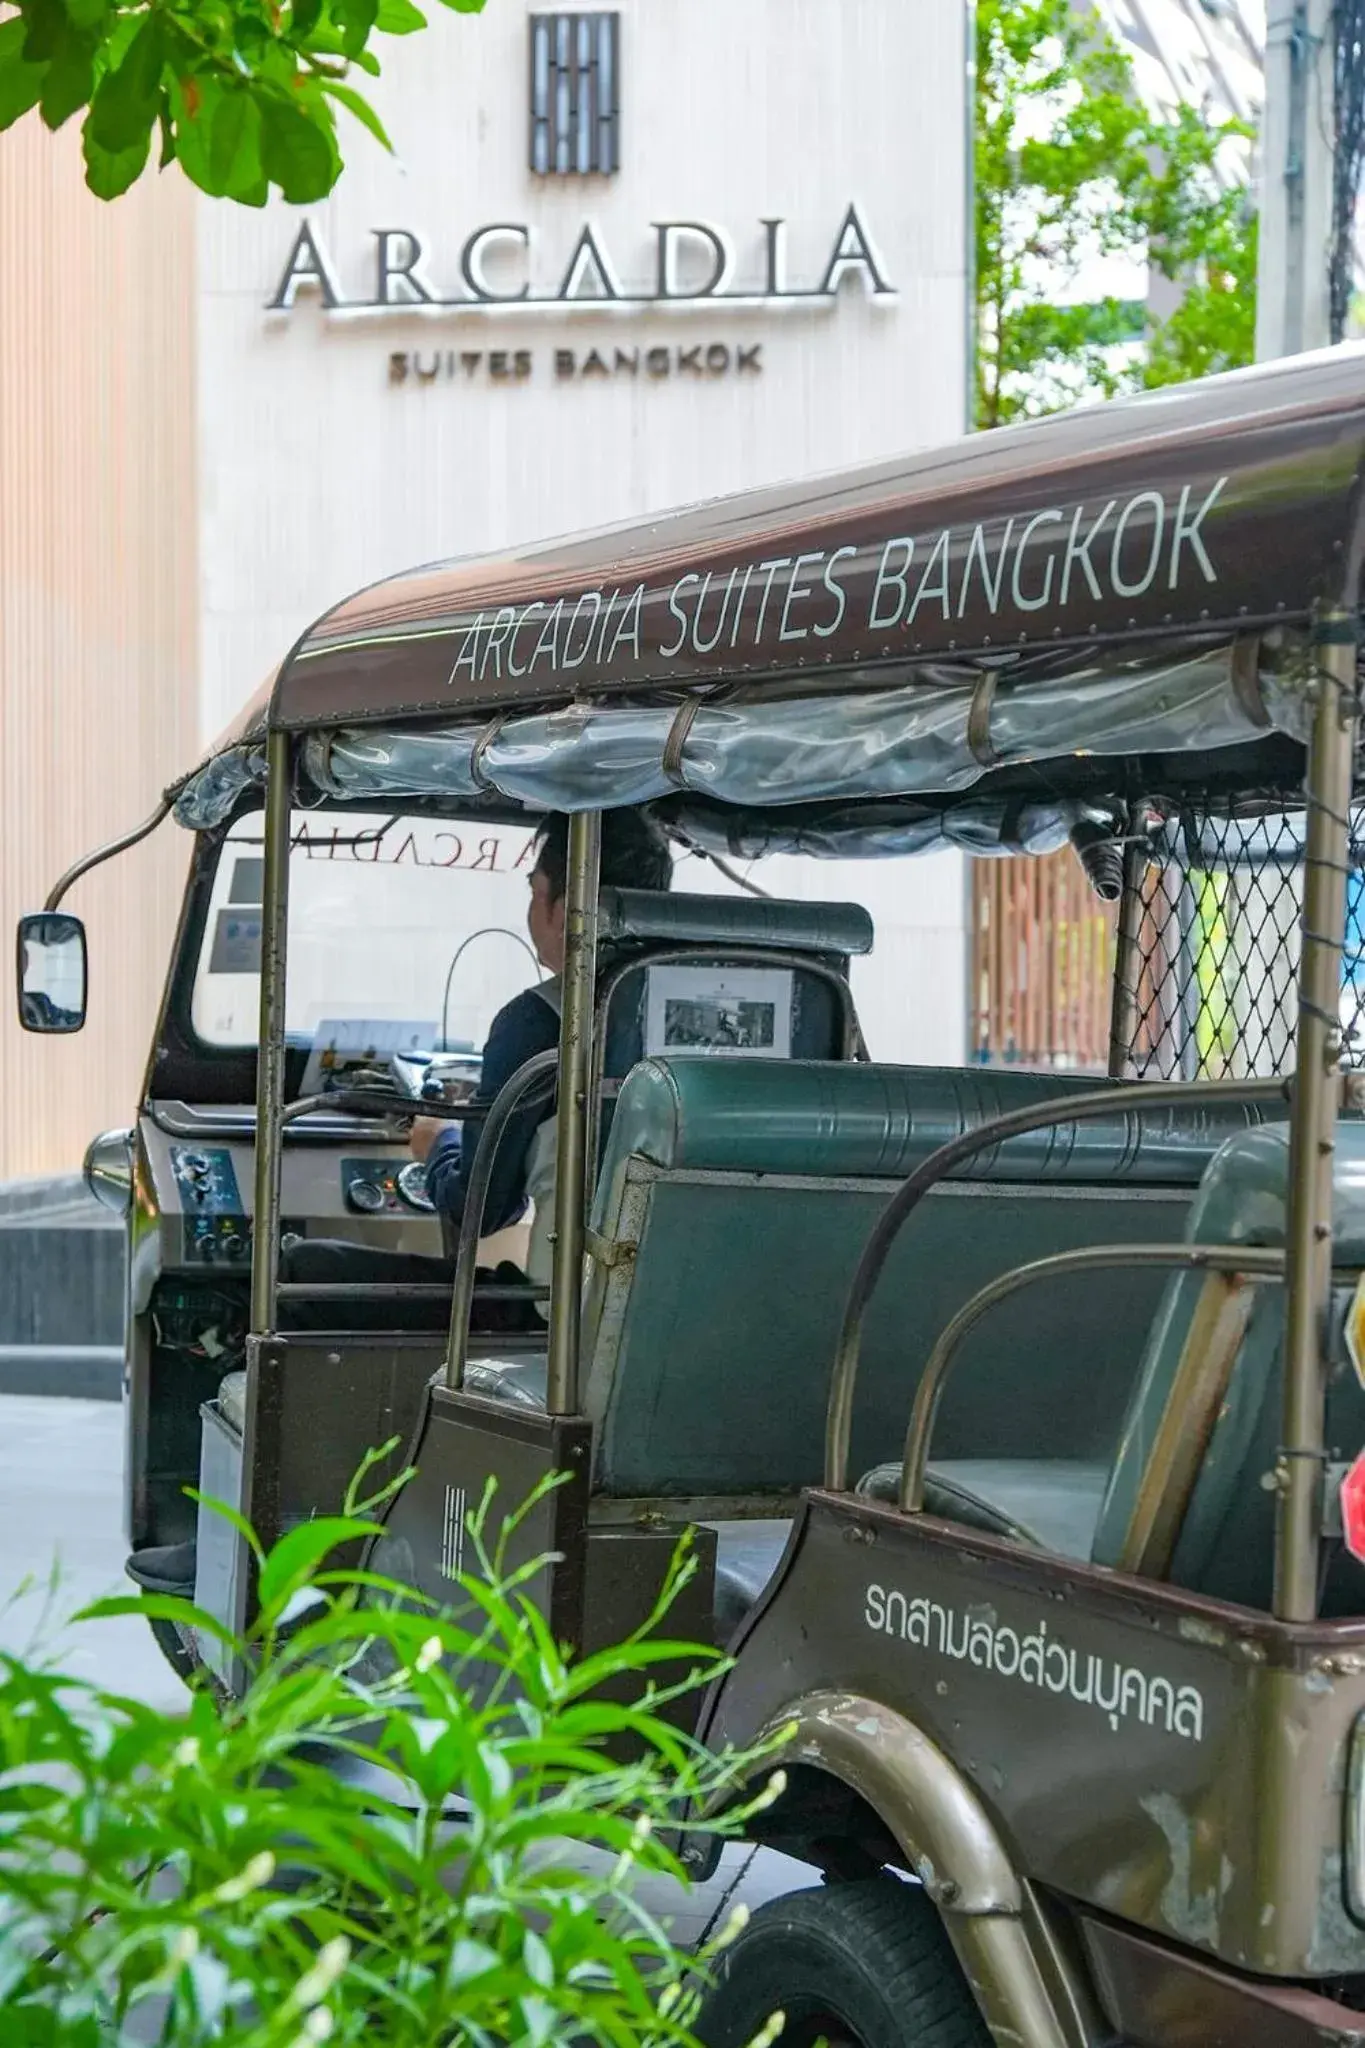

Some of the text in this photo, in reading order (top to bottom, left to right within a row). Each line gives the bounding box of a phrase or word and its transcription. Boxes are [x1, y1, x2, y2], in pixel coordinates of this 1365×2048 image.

[263, 201, 898, 311] ARCADIA
[388, 343, 765, 385] SUITES BANGKOK
[447, 475, 1230, 685] ARCADIA SUITES BANGKOK
